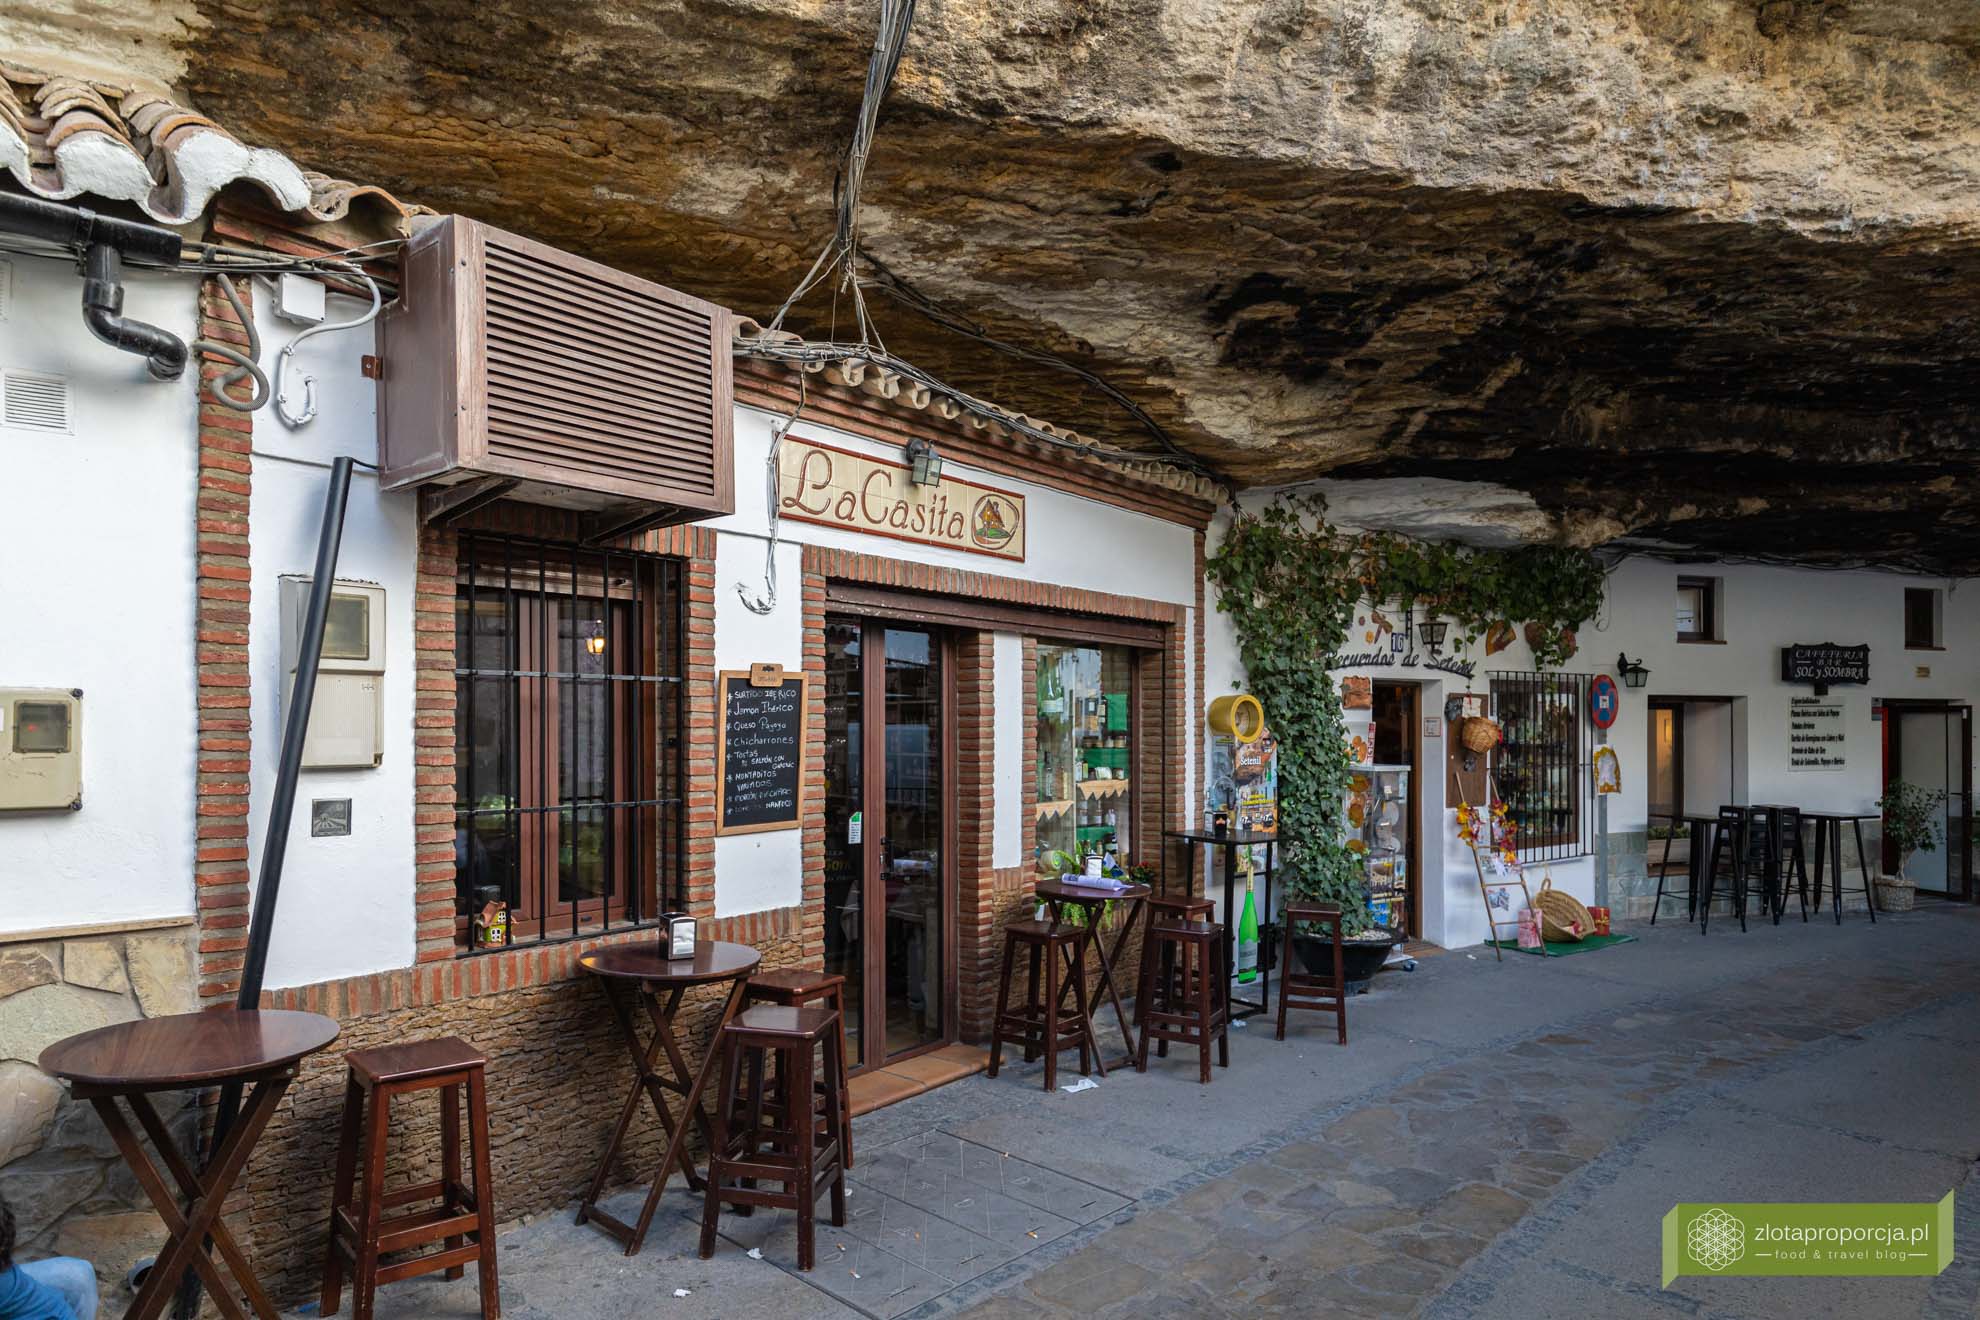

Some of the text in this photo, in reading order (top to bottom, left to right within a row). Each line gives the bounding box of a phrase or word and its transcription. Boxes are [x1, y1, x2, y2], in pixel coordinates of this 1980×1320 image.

[861, 468, 965, 540] Casita
[1401, 653, 1419, 666] de
[1794, 666, 1864, 679] SOL y SOMBRA
[733, 721, 757, 732] Queso
[733, 733, 794, 747] Chicharrones
[1240, 755, 1262, 766] Setenil
[735, 770, 777, 781] MONTADITOS
